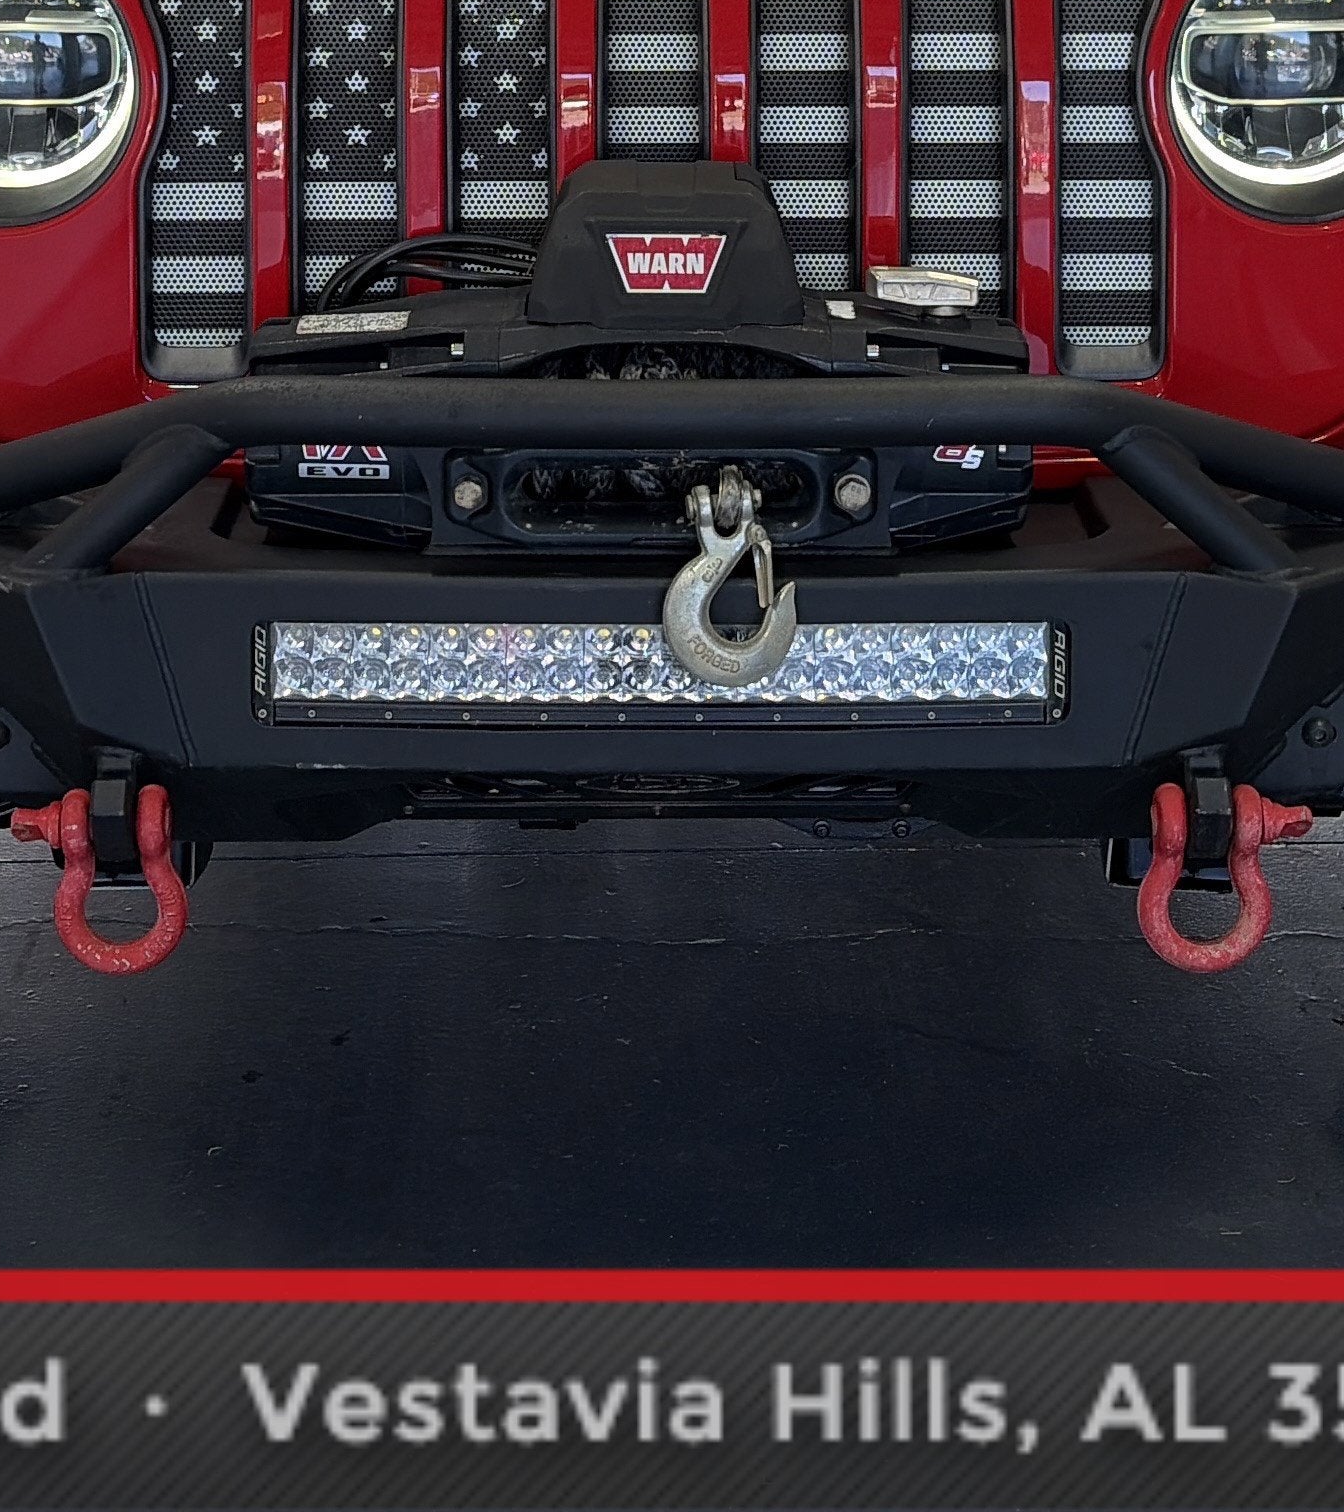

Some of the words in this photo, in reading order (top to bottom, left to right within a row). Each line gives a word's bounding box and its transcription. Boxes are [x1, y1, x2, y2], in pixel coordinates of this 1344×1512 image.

[627, 252, 704, 275] WARN
[307, 466, 380, 477] EVO
[254, 625, 267, 697] RIGID
[687, 634, 741, 674] FORGED
[1054, 628, 1066, 699] RIGID
